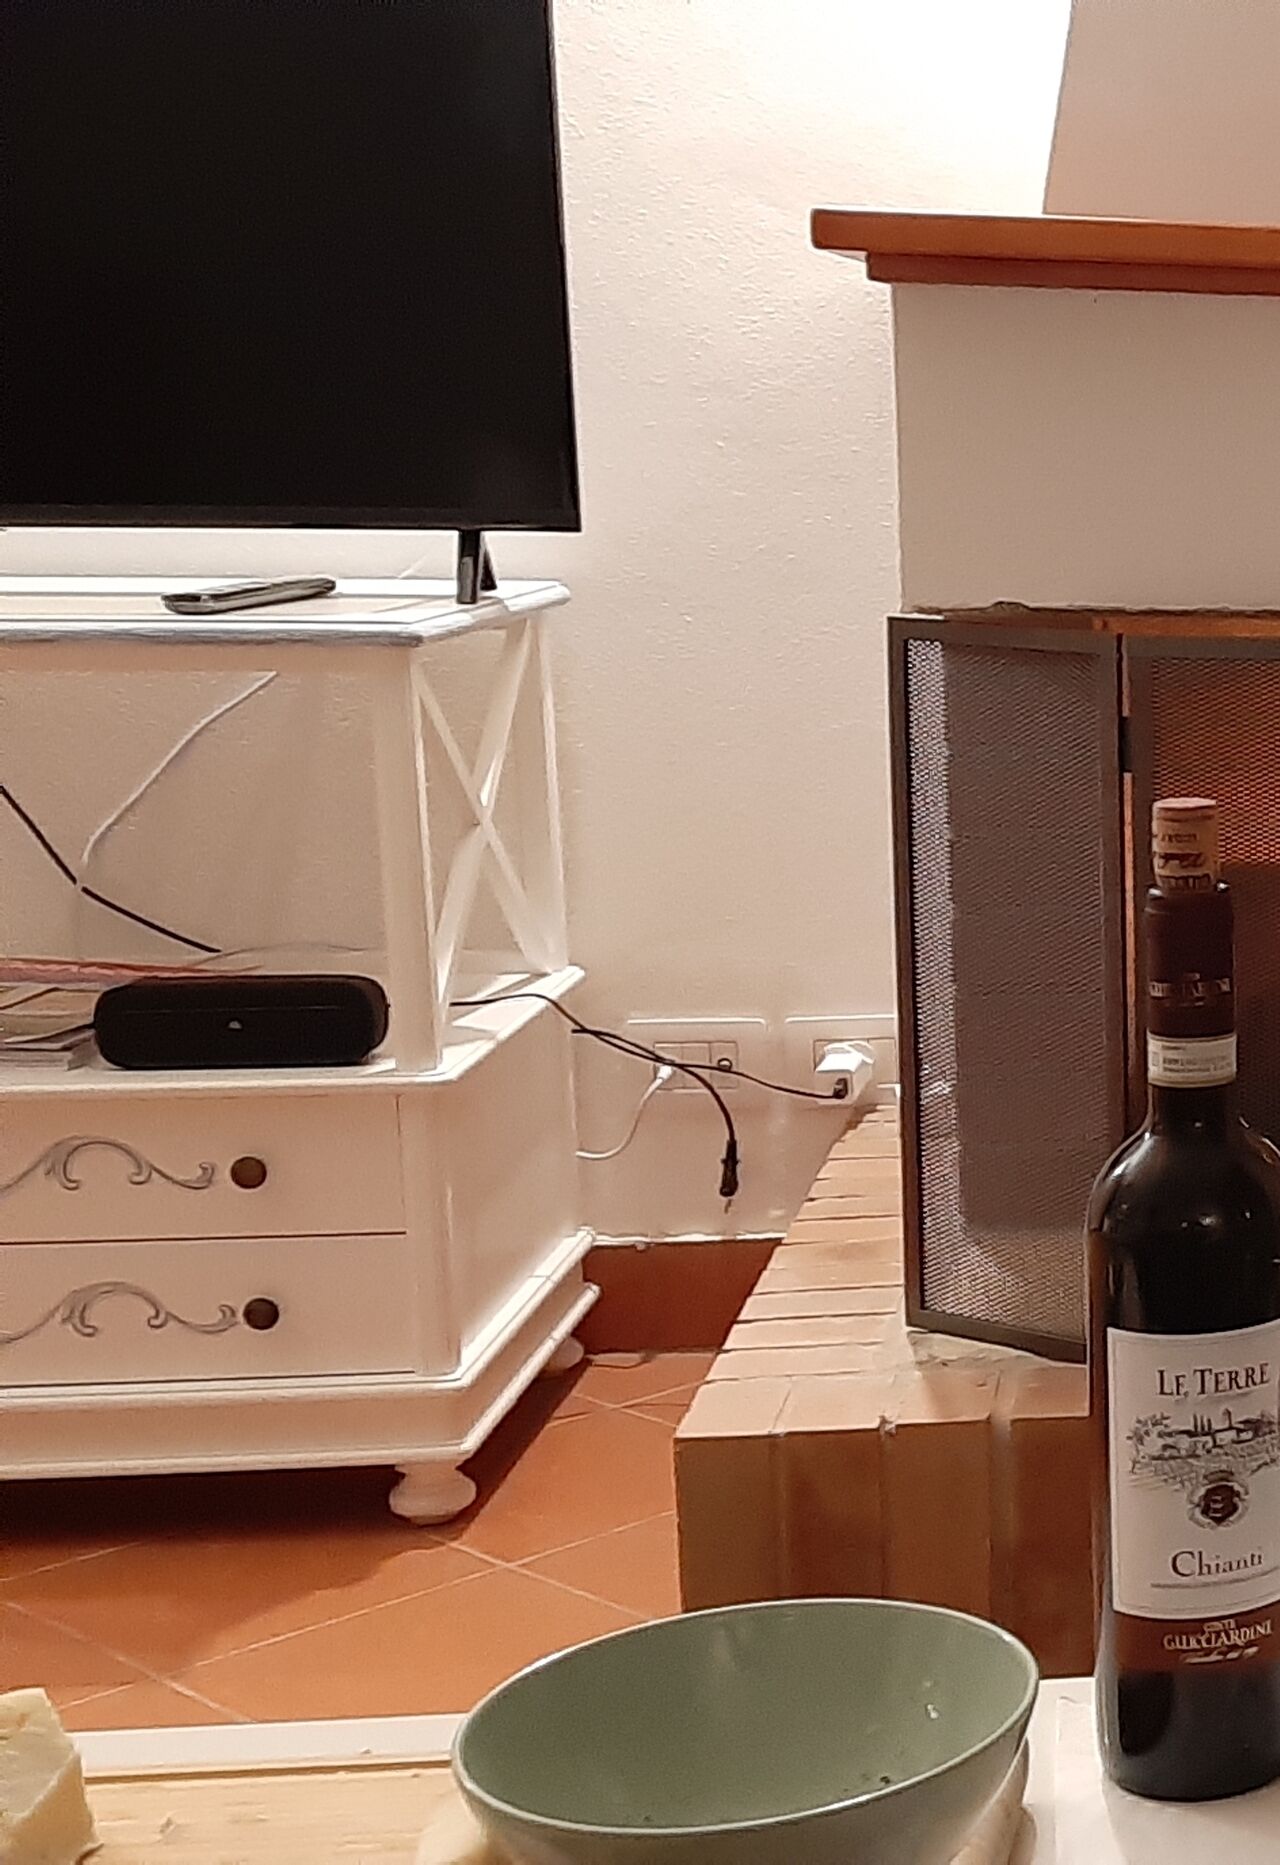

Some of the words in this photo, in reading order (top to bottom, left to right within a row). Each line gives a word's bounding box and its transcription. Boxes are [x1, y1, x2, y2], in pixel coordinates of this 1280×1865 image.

[1157, 1368, 1189, 1398] LE
[1192, 1362, 1270, 1397] TERRE
[1170, 1549, 1263, 1578] Chianti
